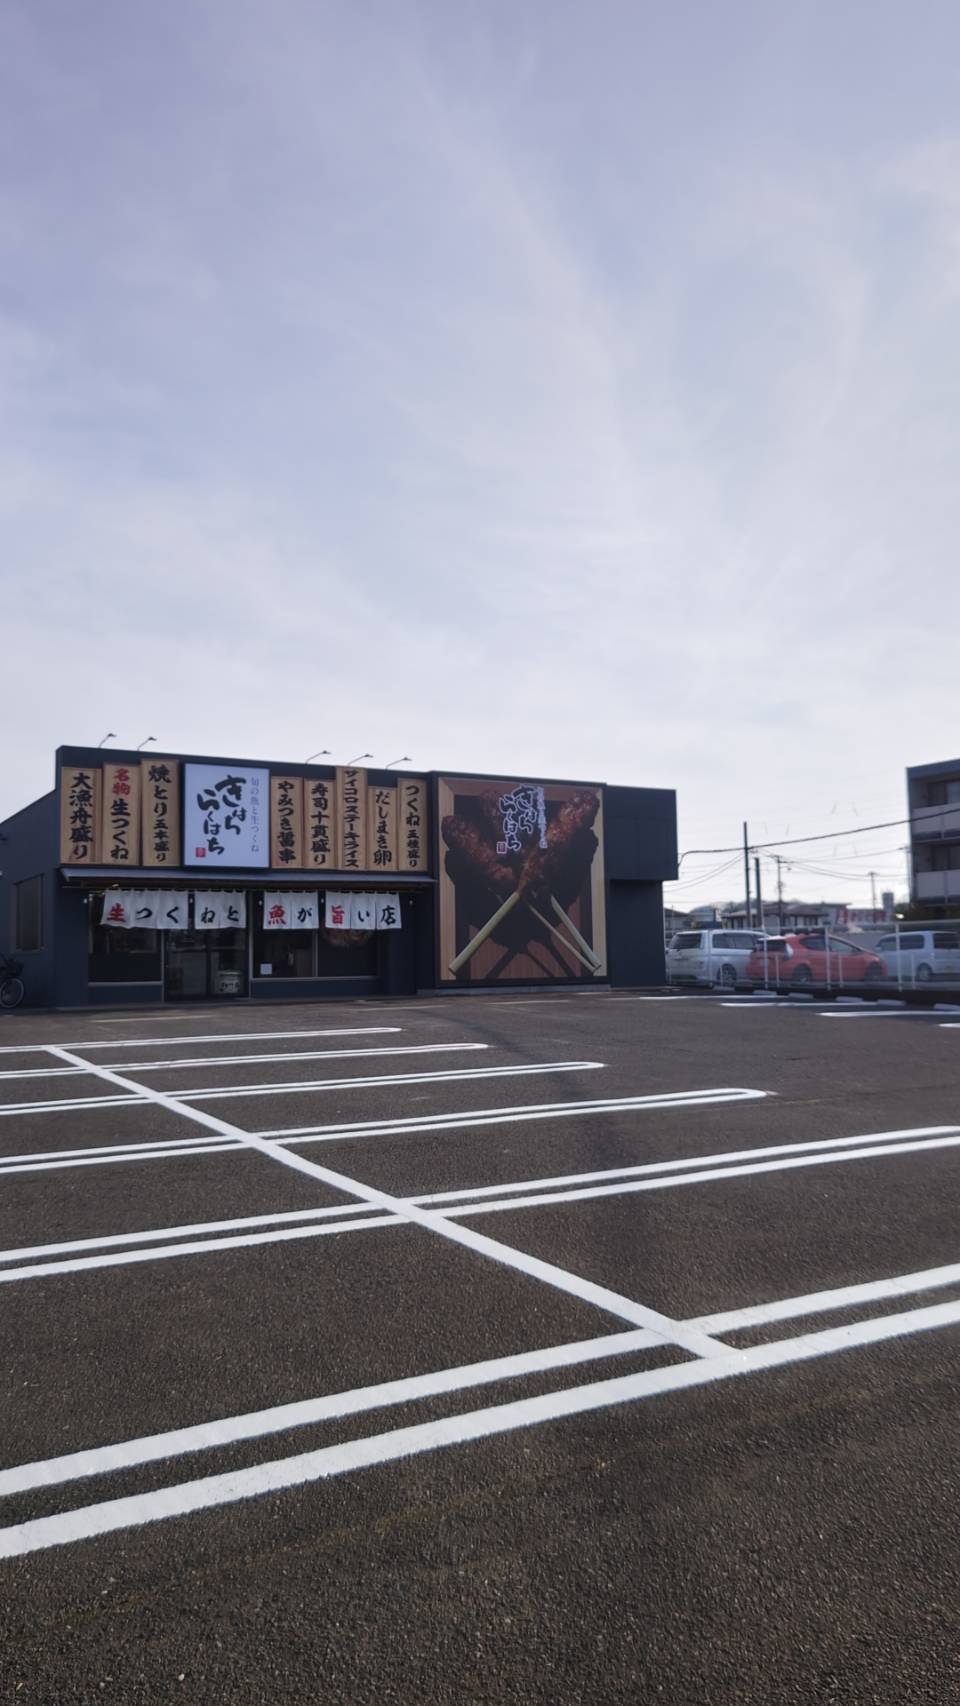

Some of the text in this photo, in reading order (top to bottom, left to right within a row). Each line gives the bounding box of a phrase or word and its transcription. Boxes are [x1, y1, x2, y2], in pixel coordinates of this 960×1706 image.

[69, 772, 94, 860] 大漁舟盛り
[310, 782, 331, 865] 寿司十貫盛り
[343, 769, 360, 868] サイコロステーキライス
[373, 790, 393, 867] だしまき卵
